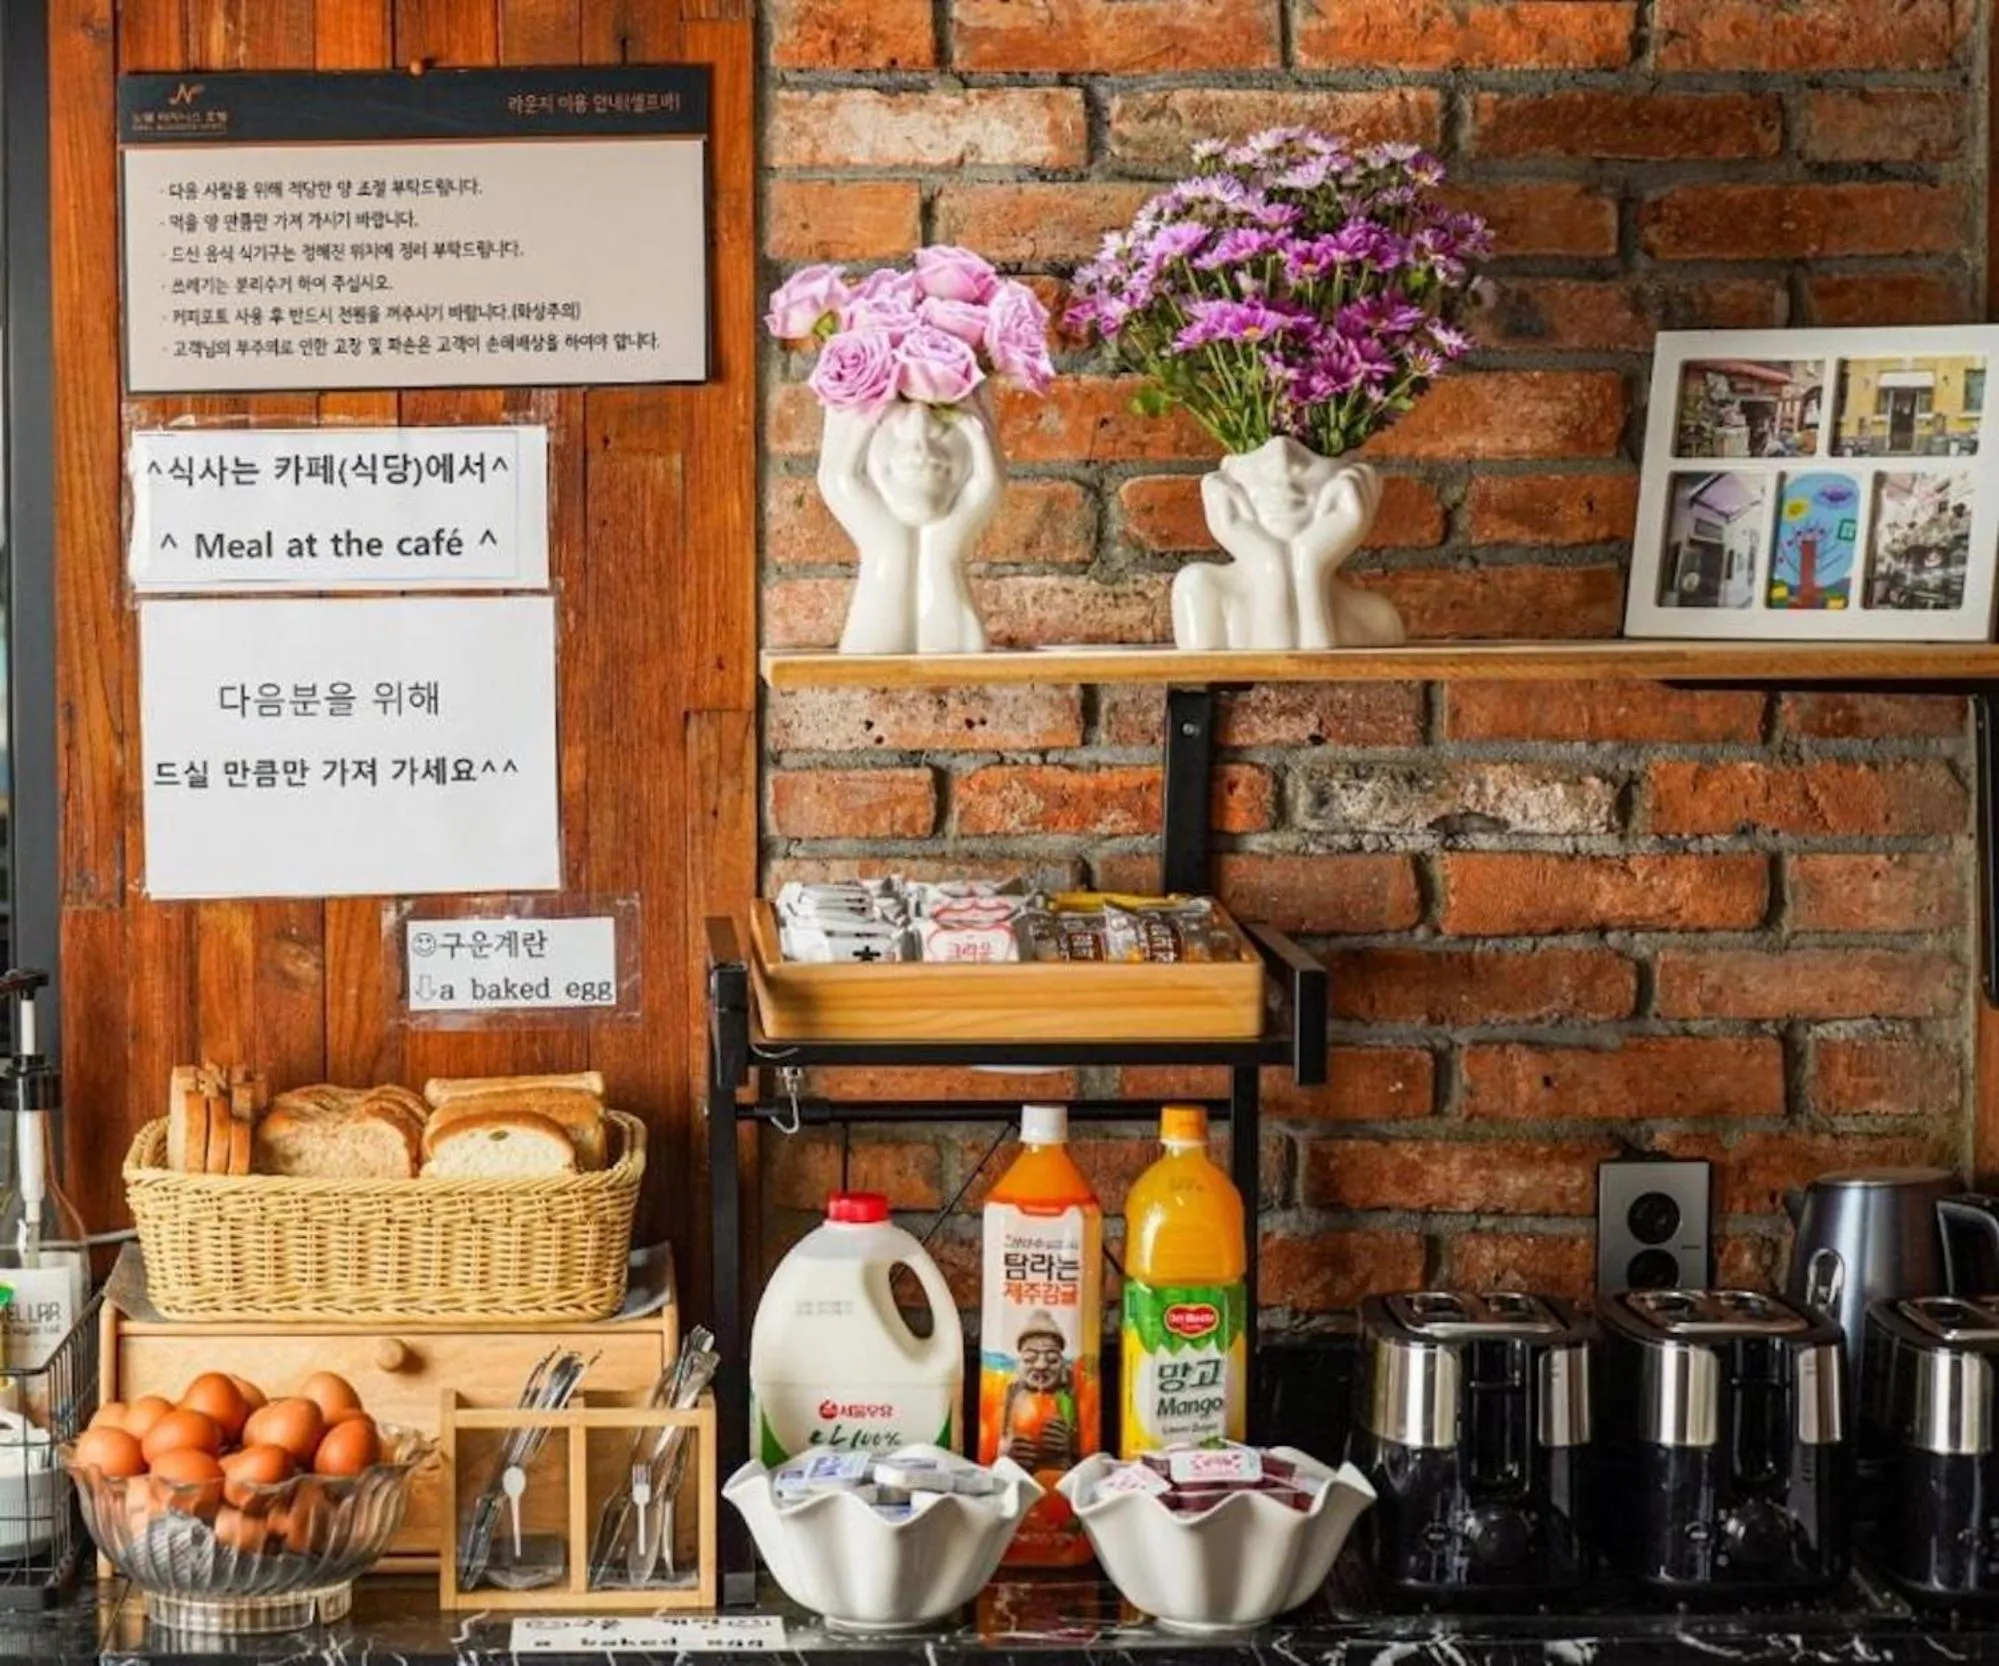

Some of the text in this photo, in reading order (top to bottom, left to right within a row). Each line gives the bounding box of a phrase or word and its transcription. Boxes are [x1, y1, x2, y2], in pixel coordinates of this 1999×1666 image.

[508, 94, 553, 115] 라운지
[558, 93, 589, 114] 이용
[169, 177, 482, 200] 다음 사람을 위해 적당한 양 조절 부탁드립니다.
[169, 209, 418, 233] 먹을 양 만큼만 가져 가시기 바랍니다.
[171, 239, 524, 264] 드신 음식 식기구는 정해진 위치에 정리 부탁드립니다.
[172, 273, 393, 296] 쓰레기는 분리수거 하여 주십시오.
[173, 301, 581, 327] 커피포트 사용 후 반드시 전원을 꺼주시기 바랍니다.(화상주의)
[173, 331, 660, 360] 고객님의 부주의로 인한 고장 및 파손은 고객이 손해배상을 하여야 합니다.
[196, 530, 272, 559] Meal
[287, 533, 317, 558] at
[330, 528, 383, 557] the
[397, 527, 463, 557] café
[219, 681, 439, 718] 다음분을 위해
[154, 761, 208, 789] 드실
[224, 759, 310, 788] 만큼만
[322, 758, 377, 787] 가져
[440, 929, 547, 960] 구운계란
[440, 977, 614, 1001] a baked egg
[1004, 1252, 1080, 1281] 탐라는
[1158, 1359, 1222, 1393] 망고
[1156, 1396, 1223, 1419] Mango
